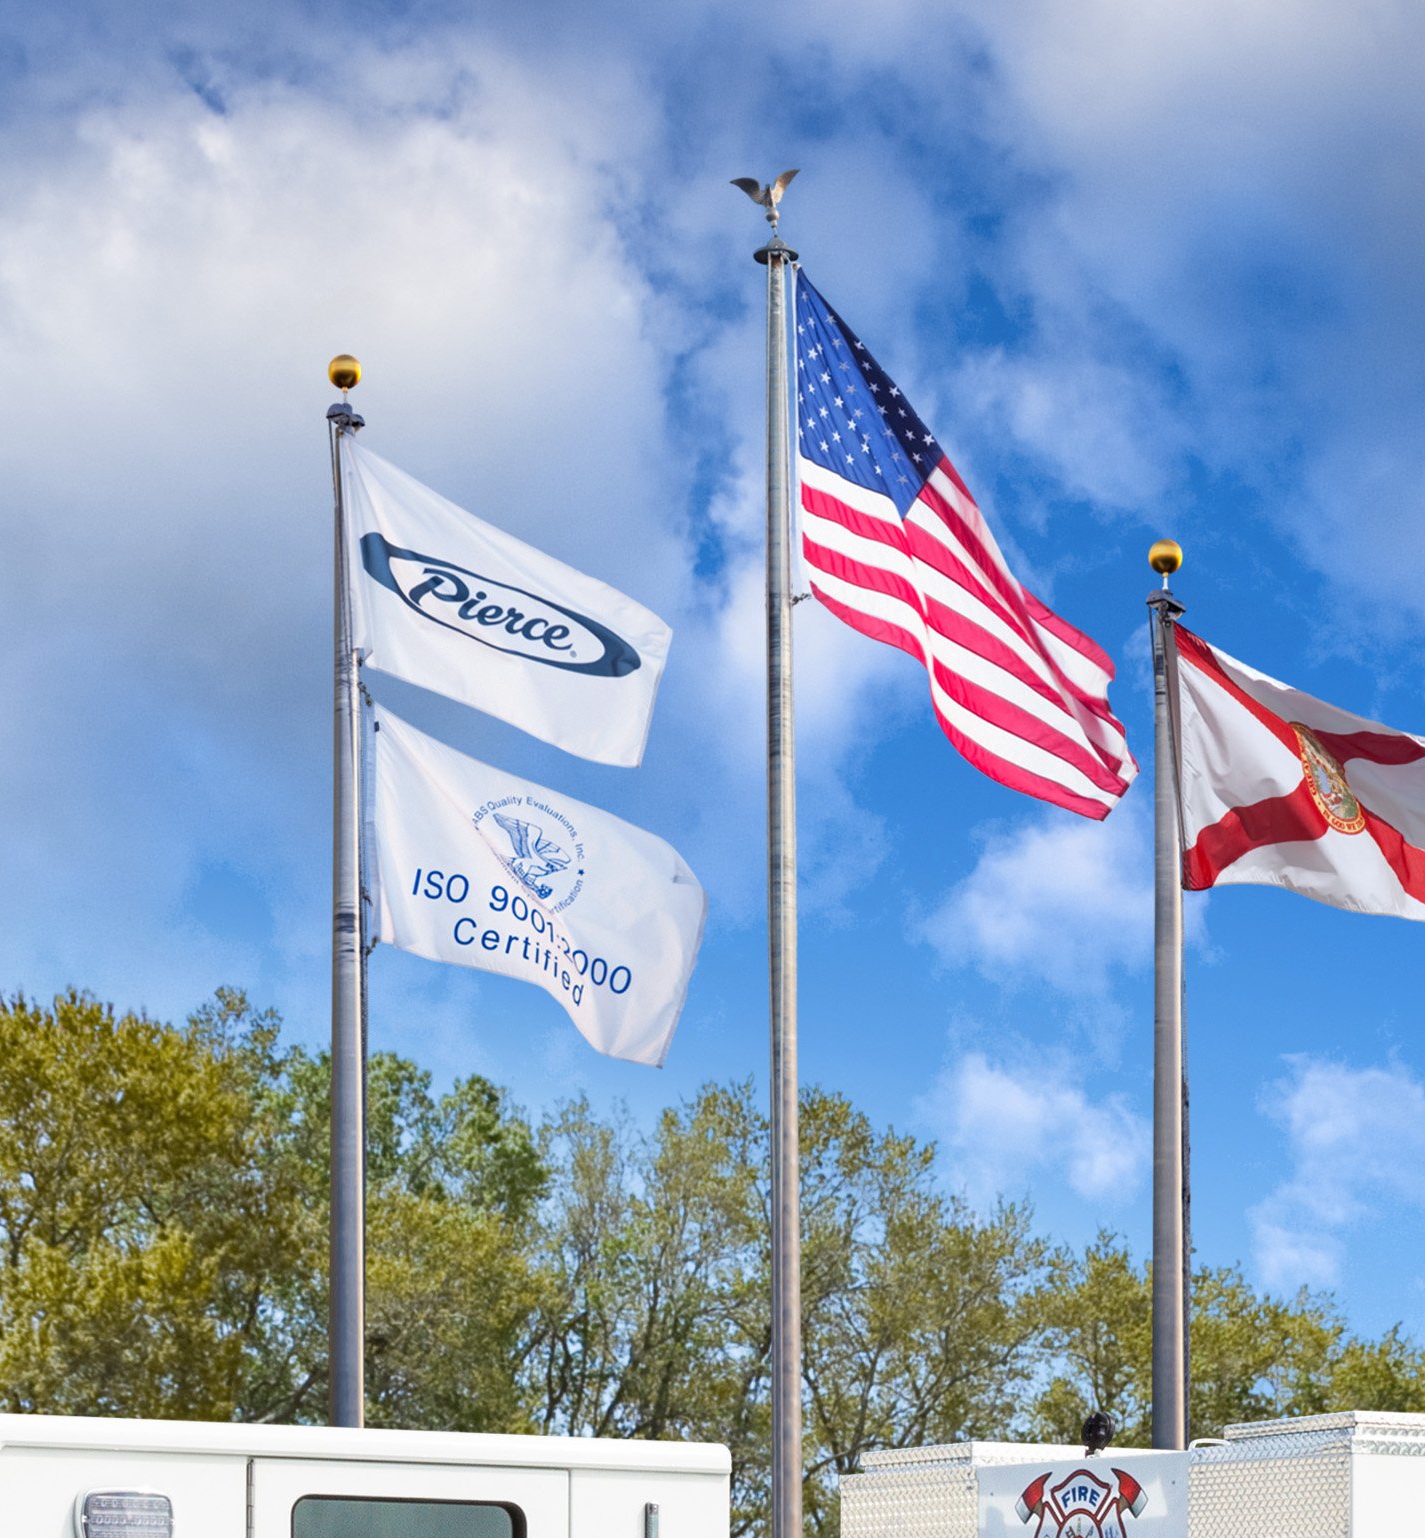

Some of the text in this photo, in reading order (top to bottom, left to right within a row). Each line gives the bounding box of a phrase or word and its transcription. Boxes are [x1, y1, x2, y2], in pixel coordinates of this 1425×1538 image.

[408, 567, 574, 651] Pierce
[472, 796, 585, 863] ABS Quality Evaluations, Inc.
[412, 868, 632, 995] ISO 9001:2000
[549, 878, 584, 915] rtification
[453, 917, 584, 1007] Certified
[1061, 1485, 1101, 1509] FIRE
